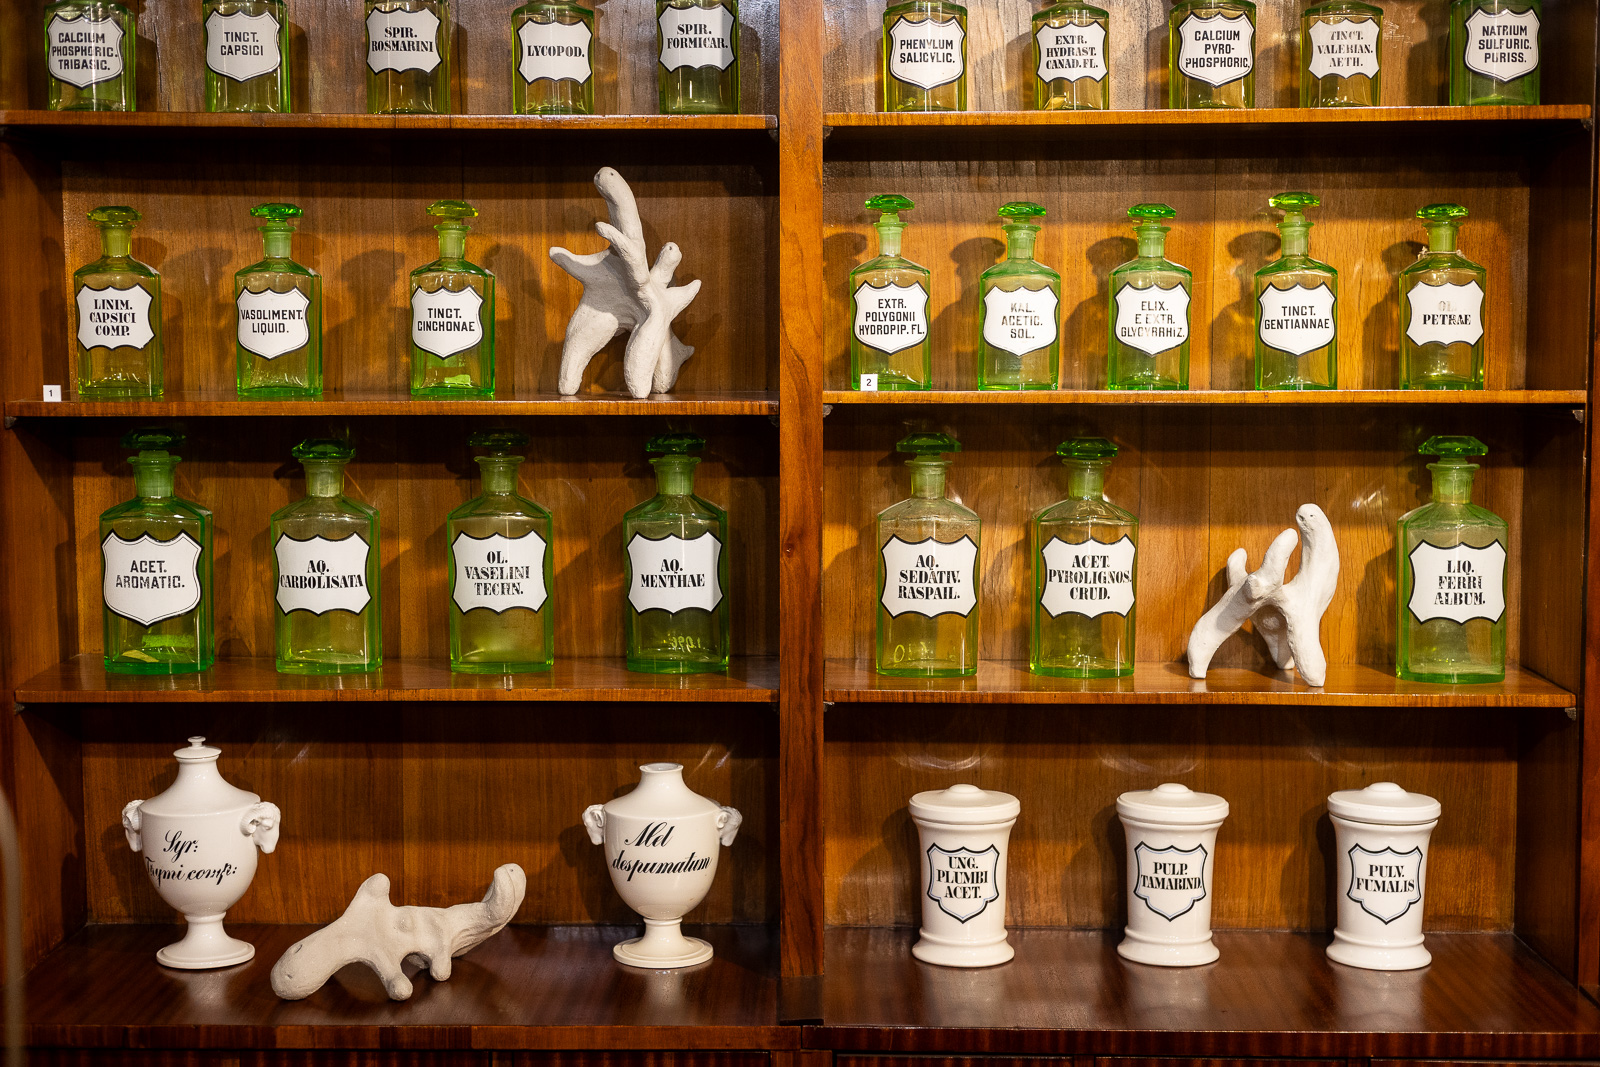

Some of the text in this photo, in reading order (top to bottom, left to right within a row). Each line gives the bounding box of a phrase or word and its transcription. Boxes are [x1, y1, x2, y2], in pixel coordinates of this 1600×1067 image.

[385, 26, 417, 38] SPIR.
[677, 24, 711, 35] SPIR.
[1195, 30, 1240, 41] CALCIUM
[1331, 31, 1363, 40] TINCT.
[1482, 25, 1527, 36] NATRIUM
[59, 32, 105, 43] CALCIUM
[224, 32, 258, 42] TINCT.
[667, 36, 729, 49] FORMICAR.
[1055, 35, 1087, 45] EXTR.
[221, 45, 263, 55] CAPSICI
[370, 39, 433, 53] ROSMARINI
[900, 39, 953, 49] PHENYLUM
[1205, 44, 1234, 54] PYRO-
[1318, 44, 1373, 54] VALERIAN.
[1479, 38, 1532, 50] SULFURIC.
[51, 45, 118, 57] PHOSPHORIC.
[528, 45, 584, 57] LYCOPOD.
[1046, 47, 1096, 57] HYDRAST.
[900, 52, 955, 63] SALICYLIC.
[1186, 56, 1251, 68] PHOSPHORIC.
[1330, 57, 1363, 67] AETH.
[1485, 52, 1526, 63] PURISS.
[58, 59, 110, 70] TRIBASIC.
[1046, 59, 1098, 69] CANAD. FL.
[94, 299, 132, 310] LINIM.
[878, 299, 906, 308] EXTR.
[1011, 303, 1034, 312] KAL.
[1142, 301, 1168, 311] ELIX.
[240, 309, 304, 321] VASOLIMENT.
[428, 308, 461, 318] TINCT.
[866, 312, 915, 322] POLYGONII
[1282, 306, 1315, 316] TINCT.
[90, 312, 136, 323] CAPSICI
[1002, 316, 1042, 325] ACETIC.
[1135, 314, 1175, 324] E EXTR.
[1423, 314, 1470, 325] PETRAE
[252, 323, 289, 335] LIQUID.
[418, 321, 475, 331] CINCHONAE
[858, 324, 924, 336] HYDROPIP. FL.
[1265, 319, 1329, 329] GENTIANNAE
[95, 325, 129, 336] COMP.
[1011, 329, 1034, 338] SOL.
[1121, 327, 1184, 337] GLYCYRRHIZ.
[866, 378, 872, 387] 2
[48, 389, 53, 398] 1
[487, 551, 508, 564] OL.
[916, 555, 939, 570] AQ.
[1072, 555, 1109, 568] ACET.
[130, 560, 167, 573] ACET.
[307, 560, 329, 575] AQ.
[661, 559, 683, 574] AQ.
[1448, 560, 1474, 575] LIQ.
[464, 566, 529, 580] VASELINI
[899, 569, 960, 583] SEDATIV.
[1049, 568, 1133, 585] PYROLIGNOS.
[116, 575, 184, 589] AROMATIC.
[280, 573, 363, 589] CARBOLISATA
[641, 573, 704, 588] MENTHAE
[1439, 576, 1482, 589] FERRI
[474, 583, 523, 595] TECHN.
[898, 585, 960, 599] RASPAIL.
[1070, 587, 1110, 600] CRUD.
[1435, 592, 1485, 605] ALBUM.
[624, 822, 675, 847] Mel
[612, 849, 713, 882] despumatum
[948, 856, 978, 869] UNG.
[1153, 862, 1187, 875] PULP.
[936, 869, 987, 884] PLUMBI
[1369, 865, 1404, 877] PULV.
[1140, 873, 1203, 890] TAMARIND.
[1355, 877, 1414, 892] FUMALIS
[944, 886, 981, 898] ACET.
